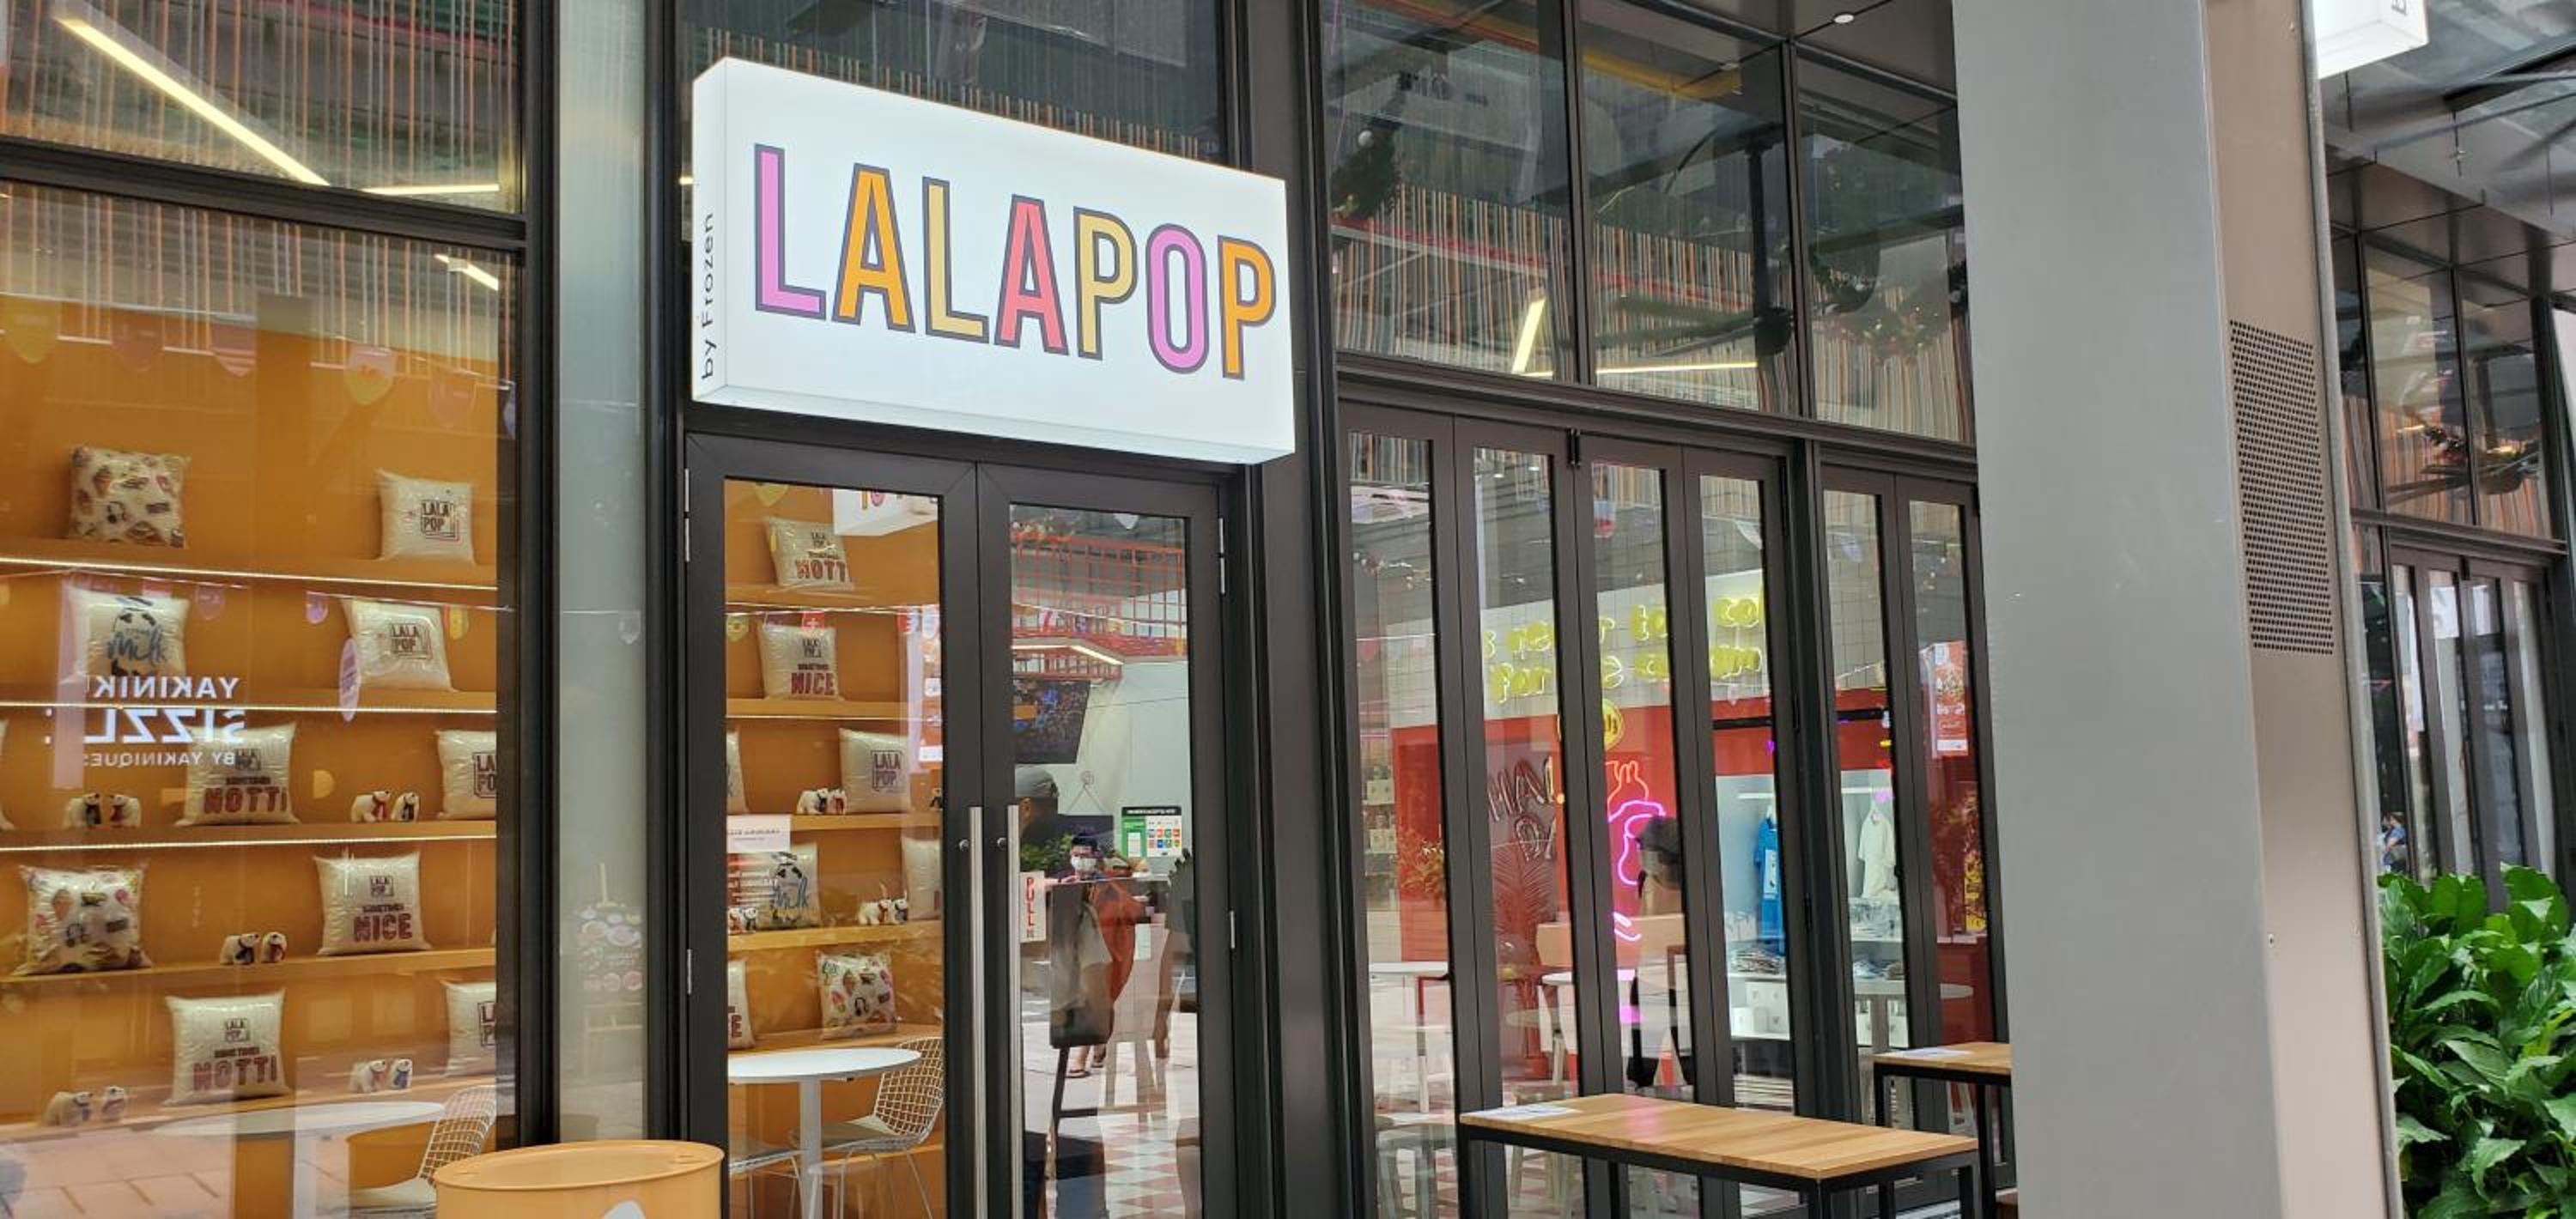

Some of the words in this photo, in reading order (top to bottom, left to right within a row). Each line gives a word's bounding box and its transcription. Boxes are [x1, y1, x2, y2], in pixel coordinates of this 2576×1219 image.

[701, 213, 714, 328] Frozen
[754, 143, 1277, 380] LALAPOP
[702, 339, 717, 379] by
[422, 501, 450, 517] LALA
[422, 517, 445, 532] POP
[791, 672, 835, 696] NICE
[873, 753, 901, 770] LALA
[204, 785, 288, 814] NOTTI
[1026, 876, 1036, 926] PULL
[354, 913, 413, 943] NICE
[192, 1054, 278, 1091] NOTTI
